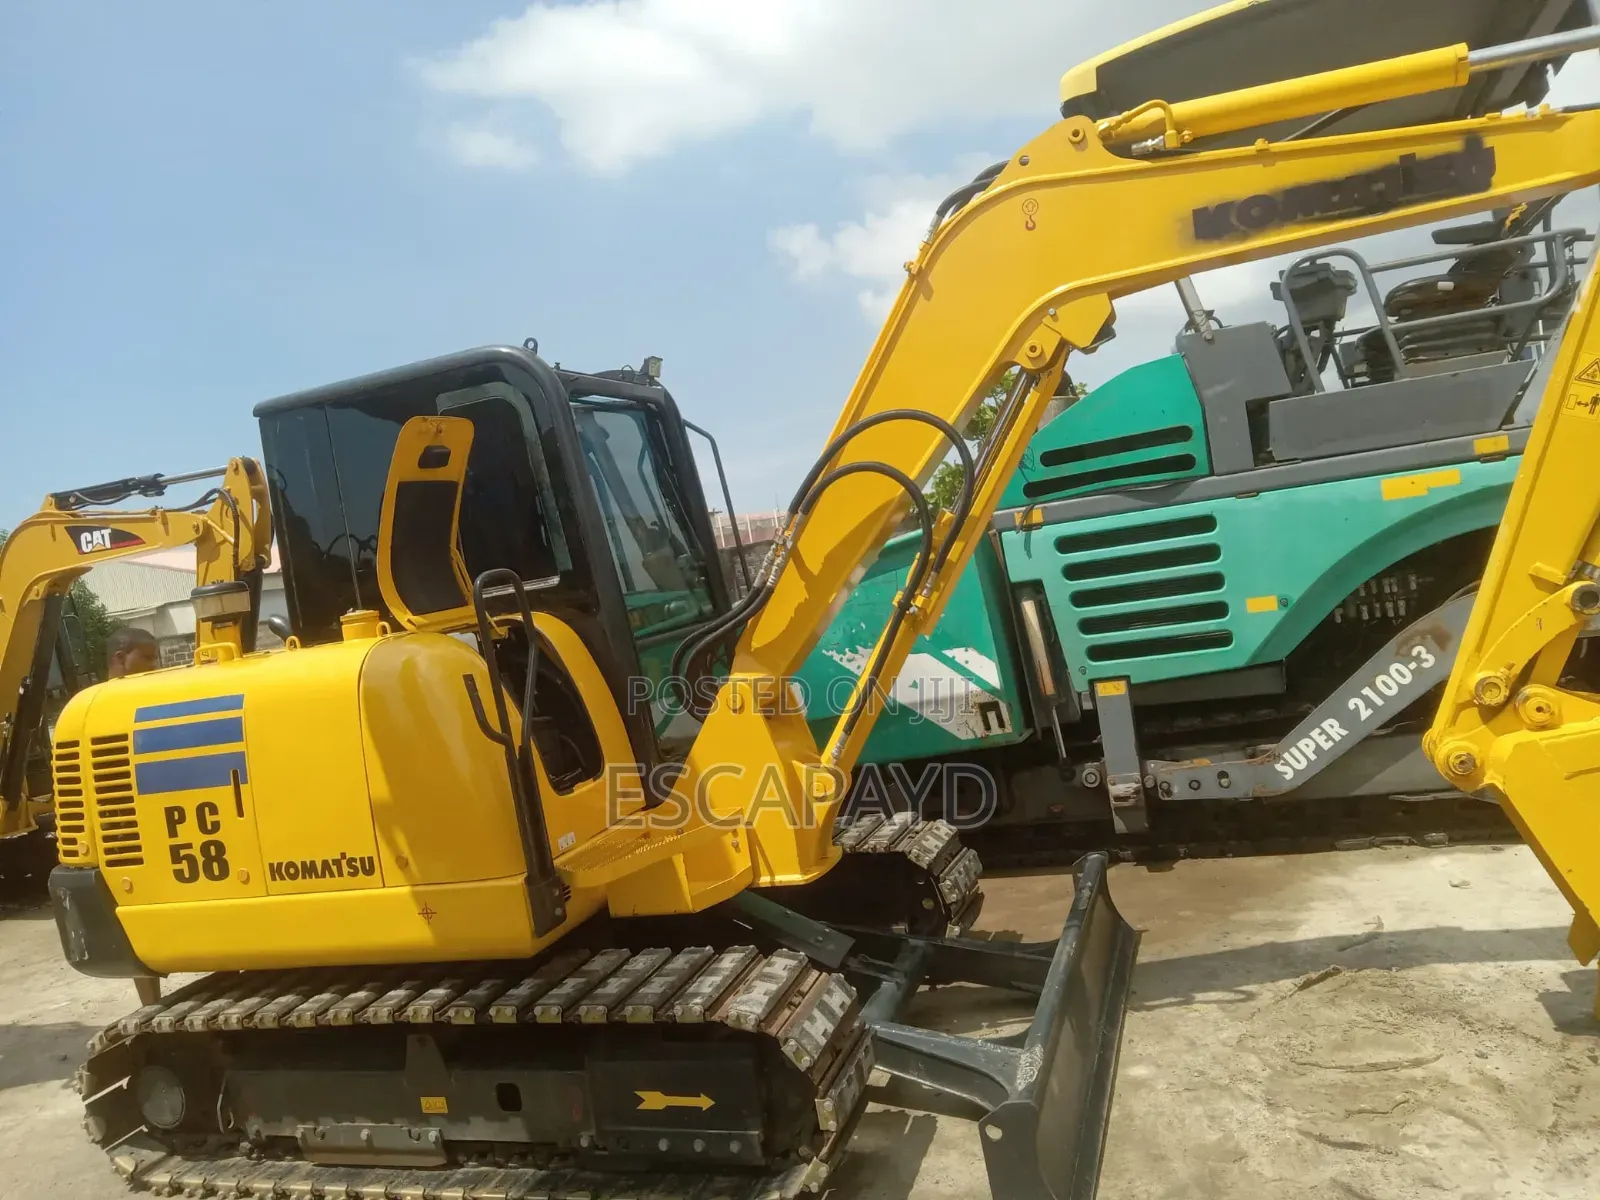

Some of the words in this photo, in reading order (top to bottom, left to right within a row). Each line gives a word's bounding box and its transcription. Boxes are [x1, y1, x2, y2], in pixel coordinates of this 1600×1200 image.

[80, 528, 112, 553] CAT
[1274, 718, 1349, 781] SUPER
[1348, 645, 1436, 722] 2100-3
[169, 839, 230, 884] 58
[268, 852, 376, 882] KOMATSU
